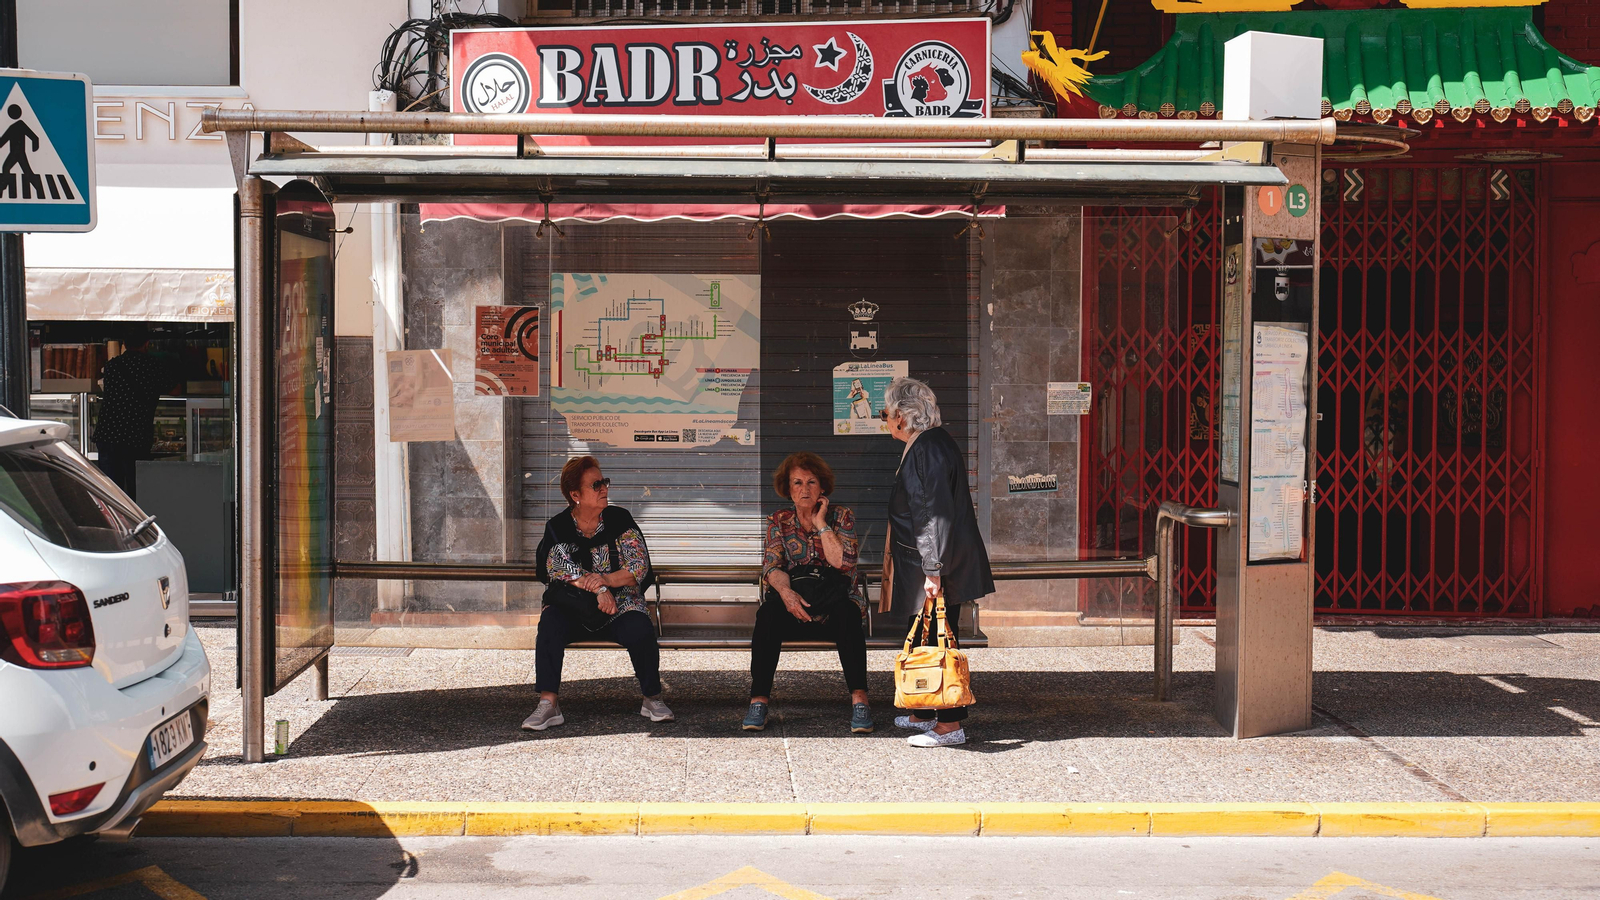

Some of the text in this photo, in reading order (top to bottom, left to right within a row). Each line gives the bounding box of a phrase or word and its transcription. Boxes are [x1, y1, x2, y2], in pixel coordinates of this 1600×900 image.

[724, 37, 803, 68] مجزرة
[904, 49, 958, 70] CARNICERÍA
[538, 43, 723, 109] BADR
[725, 68, 798, 105] بدر
[491, 93, 514, 111] HALAL
[915, 106, 950, 116] BADR
[1289, 192, 1306, 210] L3
[93, 592, 130, 609] SANDERO
